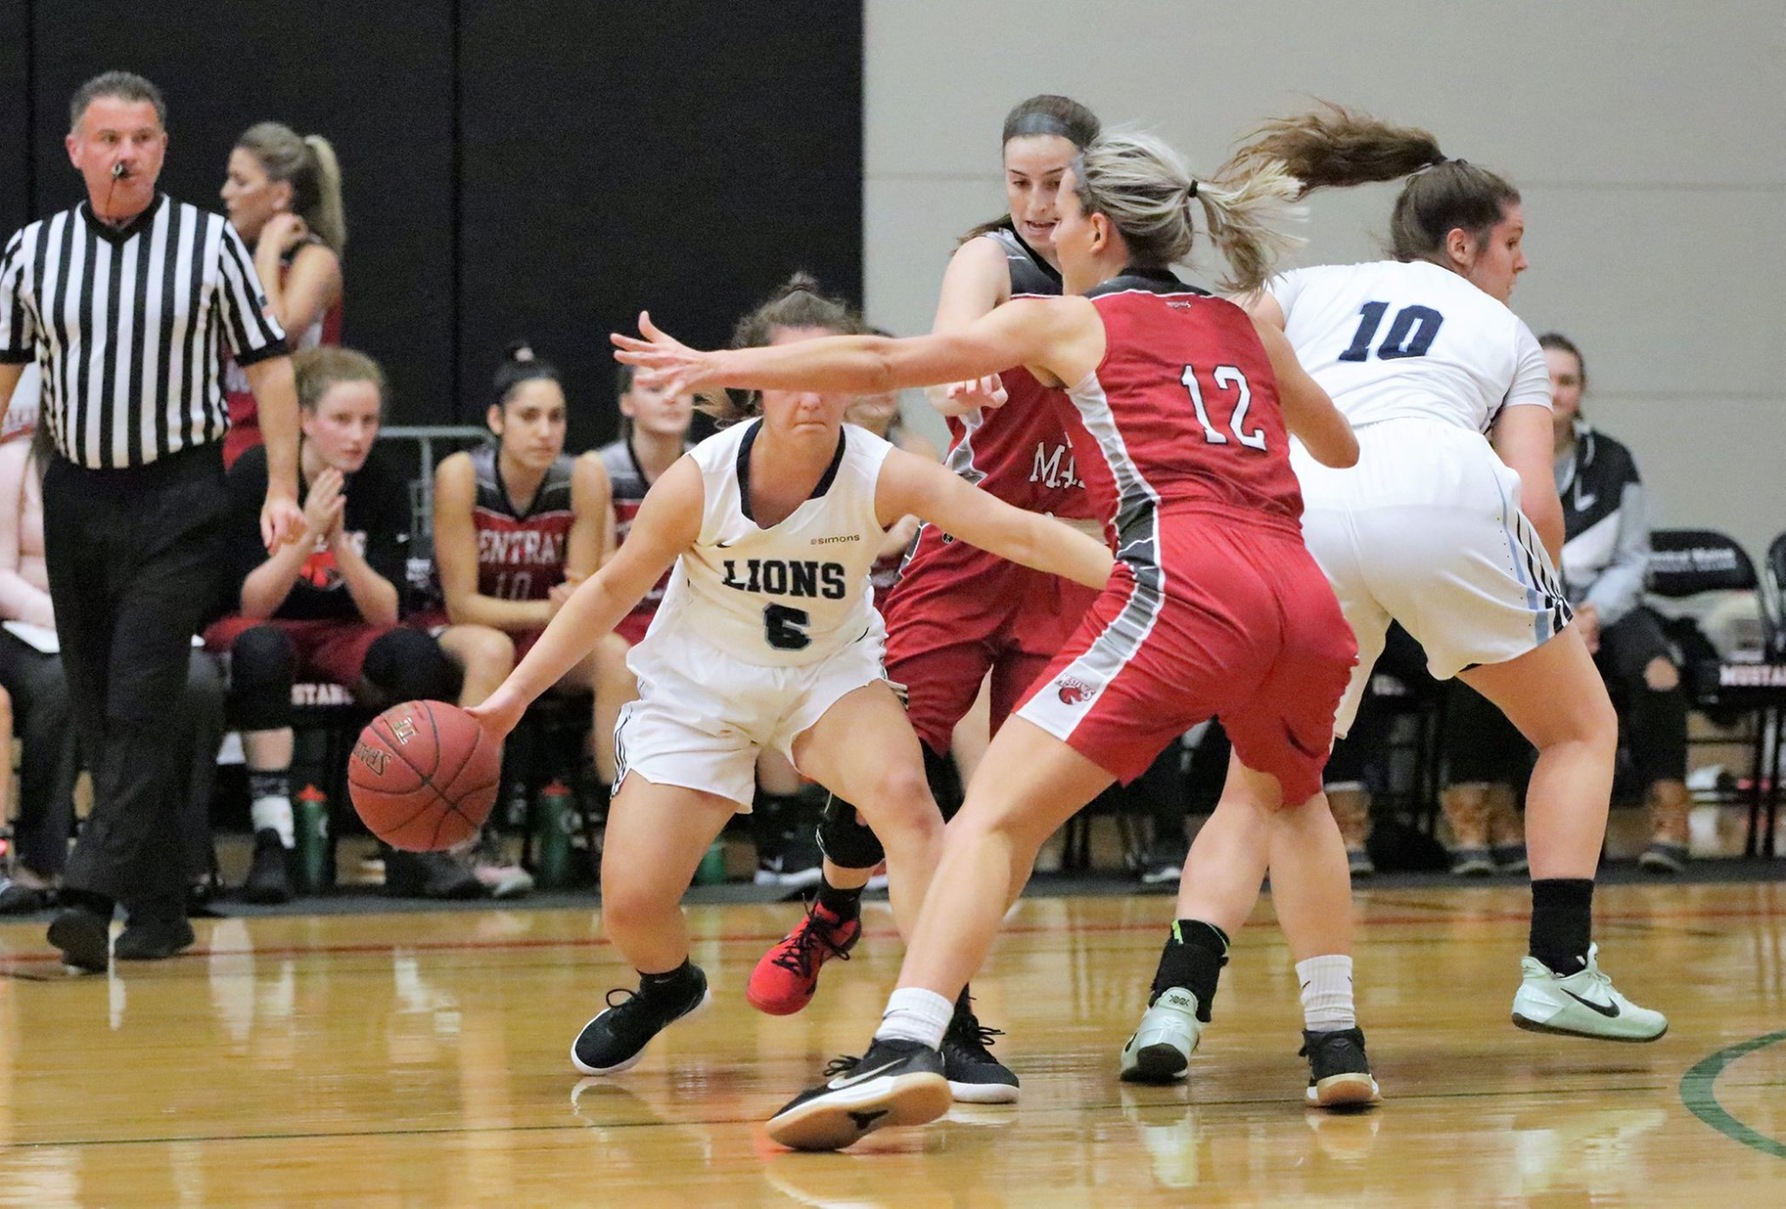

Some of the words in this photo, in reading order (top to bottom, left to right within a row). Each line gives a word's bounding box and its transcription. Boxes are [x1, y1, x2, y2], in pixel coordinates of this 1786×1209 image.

[1338, 300, 1444, 362] 10
[1180, 364, 1267, 452] 12
[1029, 434, 1086, 489] MA
[721, 558, 846, 600] LIONS
[763, 602, 811, 651] 6
